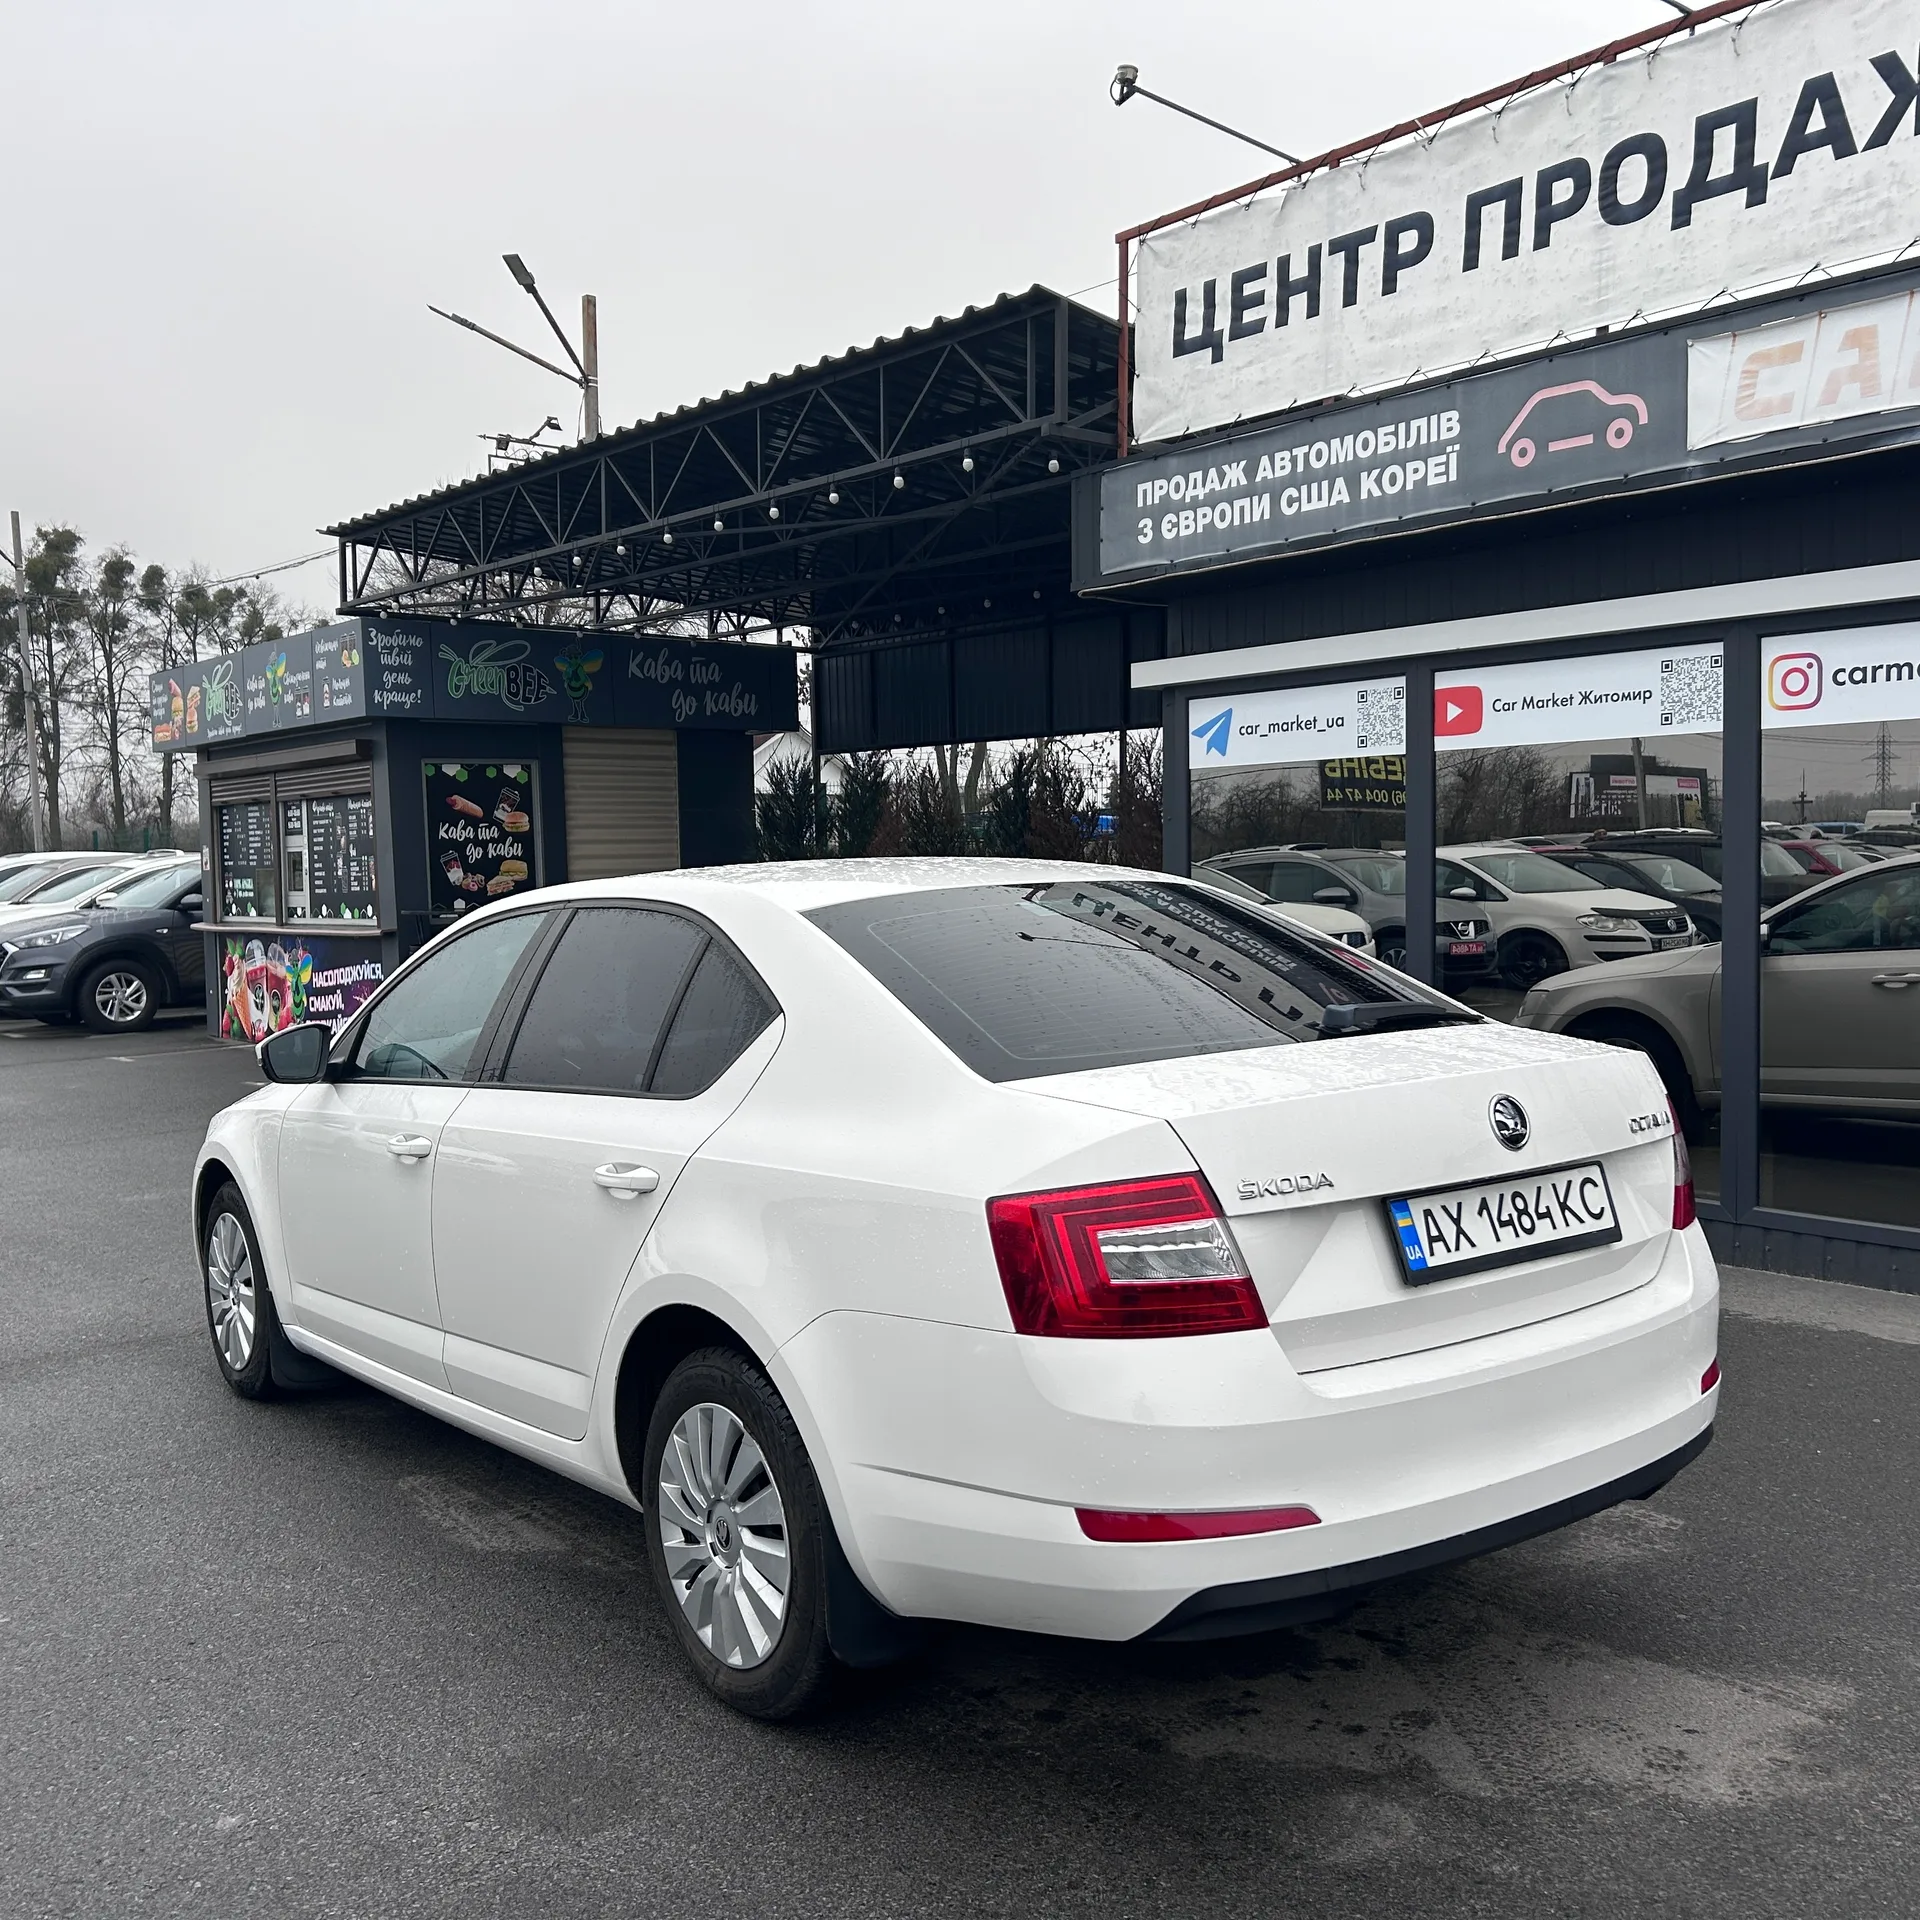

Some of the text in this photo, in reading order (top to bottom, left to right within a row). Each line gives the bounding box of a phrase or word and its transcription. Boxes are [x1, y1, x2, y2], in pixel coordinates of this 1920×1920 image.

[1172, 211, 1435, 365] ЦЕНТР
[1734, 320, 1920, 422] CA
[1137, 410, 1461, 508] ПРОДАЖ АВТОМОБІЛІВ
[1137, 444, 1461, 545] З ЄВРОПИ США КОРЕЇ
[367, 627, 424, 652] Зробимо
[380, 649, 413, 666] твій
[628, 647, 723, 685] Кава та
[382, 669, 413, 689] день
[1832, 660, 1920, 687] carm
[373, 689, 423, 710] краще!
[671, 681, 759, 722] до кави
[1492, 688, 1653, 712] Car Market Житомир
[1238, 714, 1345, 738] car_market_ua
[438, 819, 500, 842] Кава та
[465, 836, 524, 864] до кави
[312, 959, 384, 989] НАСОЛОДЖУЙСЯ,
[308, 989, 345, 1012] СМАКУЙ,
[1237, 1172, 1335, 1201] ŠKODA
[1405, 1245, 1424, 1262] UA
